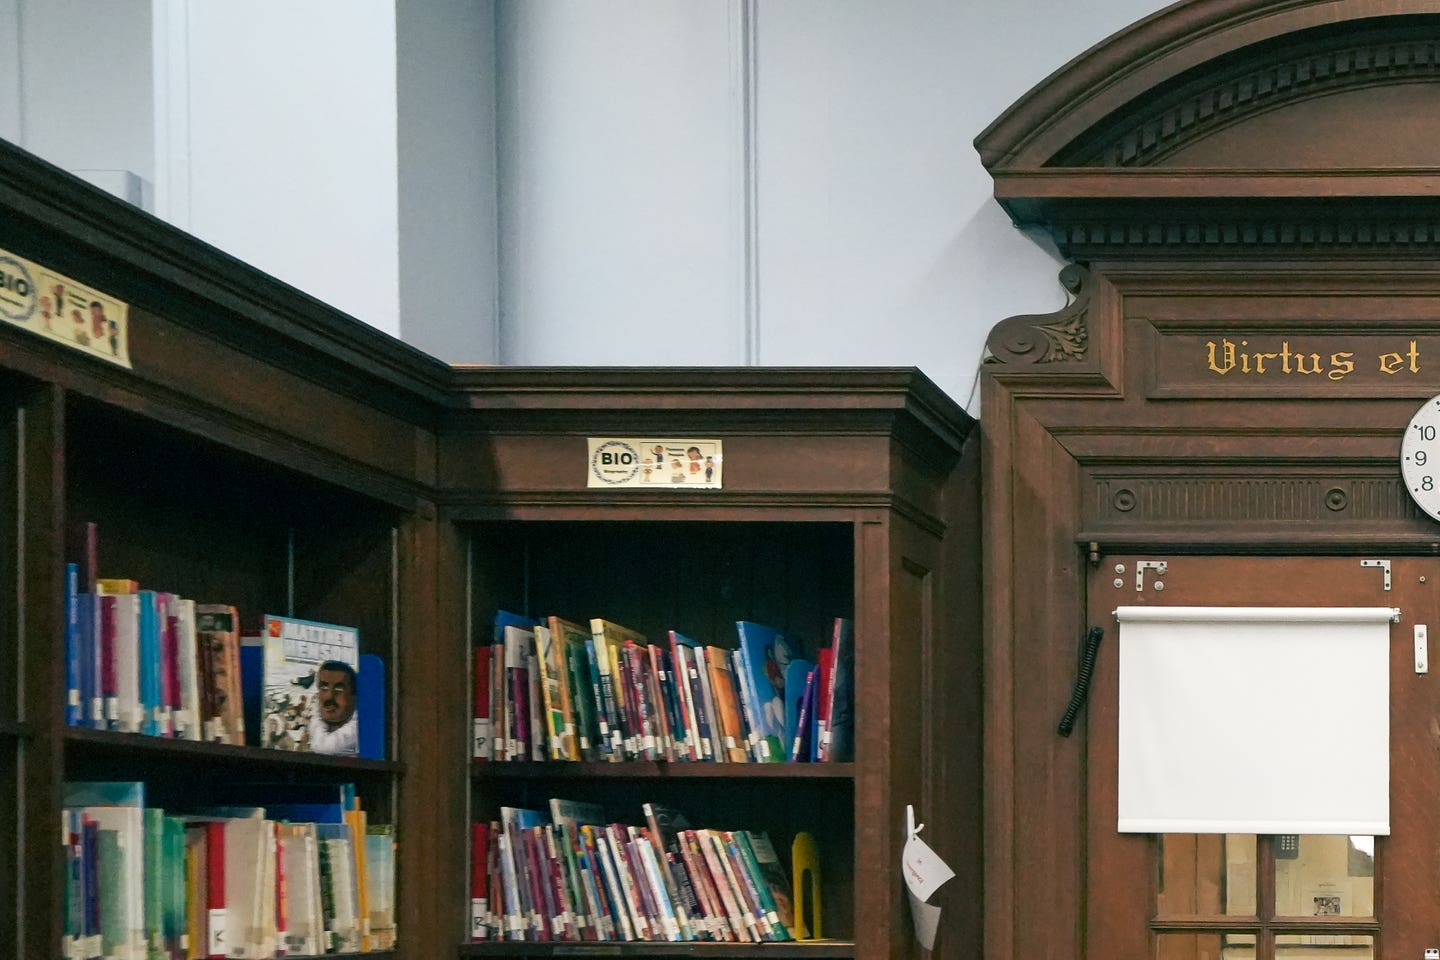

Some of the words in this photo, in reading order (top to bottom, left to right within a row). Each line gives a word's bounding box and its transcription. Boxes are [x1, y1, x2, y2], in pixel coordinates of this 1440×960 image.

[1205, 338, 1355, 381] Virtus
[1379, 340, 1421, 375] et
[1418, 426, 1436, 441] 10
[601, 452, 633, 466] BIO
[1414, 450, 1427, 467] 9
[1420, 475, 1434, 492] 8
[476, 737, 484, 749] P
